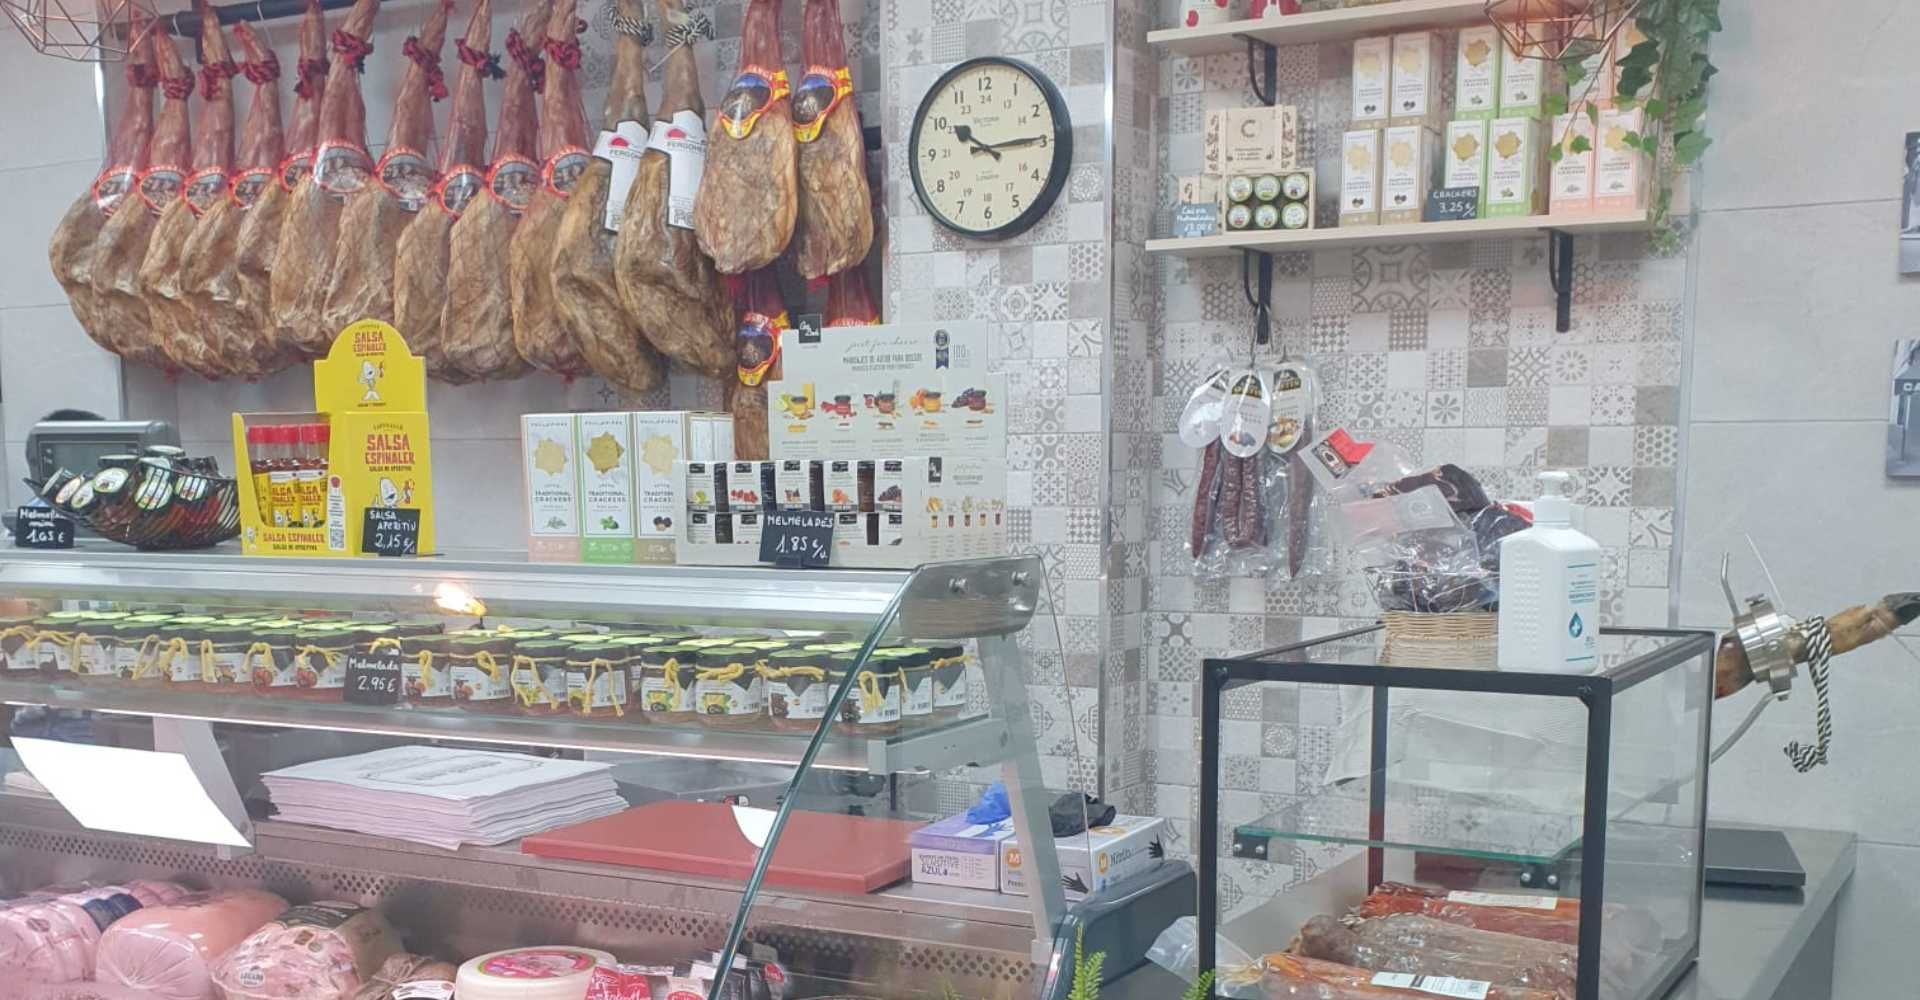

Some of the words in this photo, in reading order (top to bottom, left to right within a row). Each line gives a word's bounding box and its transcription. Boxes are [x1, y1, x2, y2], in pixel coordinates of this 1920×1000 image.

[978, 77, 992, 92] 12
[1013, 82, 1018, 96] 1
[954, 90, 964, 104] 11
[1032, 104, 1040, 118] 2
[934, 117, 947, 131] 10
[1039, 134, 1047, 148] 3
[928, 148, 936, 161] 9
[1031, 168, 1040, 181] 4
[936, 179, 945, 193] 8
[956, 201, 965, 214] 7
[1011, 194, 1020, 208] 5
[983, 206, 992, 220] 6
[354, 330, 384, 343] SALSA
[366, 432, 411, 451] SALSA
[364, 451, 416, 465] ESPINALER
[369, 509, 396, 521] SALSA
